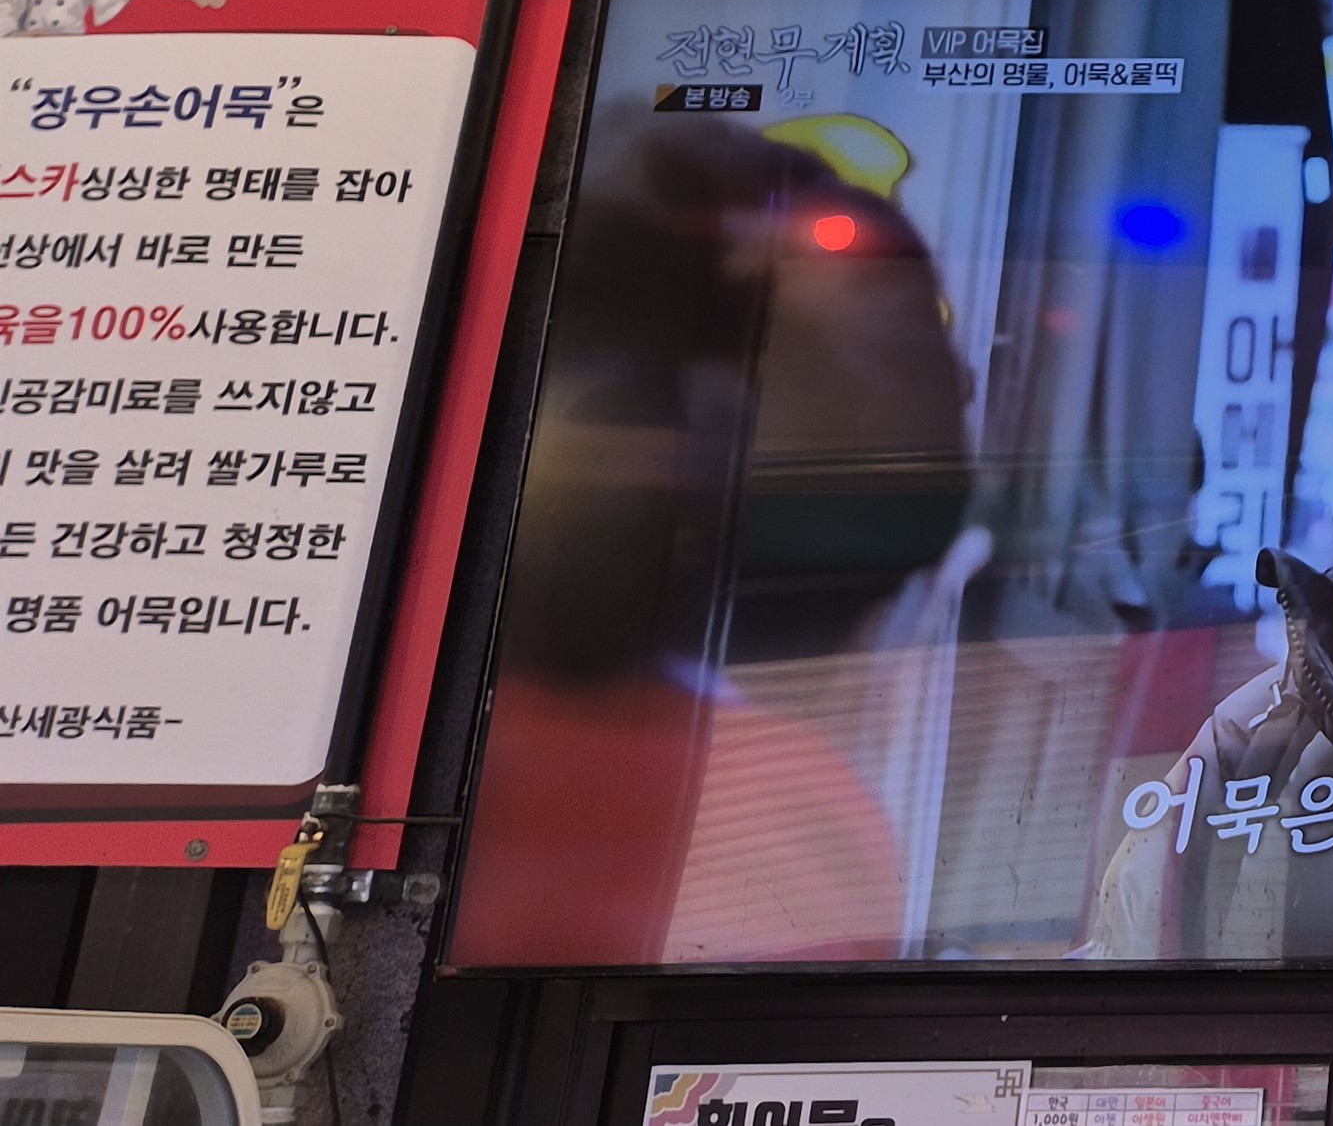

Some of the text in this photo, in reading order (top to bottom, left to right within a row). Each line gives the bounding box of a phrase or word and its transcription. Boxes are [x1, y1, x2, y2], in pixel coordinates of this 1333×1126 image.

[928, 29, 1044, 55] VIP 어묵집
[922, 61, 1178, 90] 부산의 명물, 어묵&물떡
[205, 166, 320, 202] 명태를
[335, 168, 413, 203] 잡아
[136, 233, 211, 268] 바로
[226, 234, 303, 268] 만든
[213, 378, 377, 416] 쓰지않고
[25, 449, 100, 486] 맛을
[114, 449, 192, 487] 살려
[207, 449, 367, 488] 쌀가루로
[50, 521, 207, 560] 건강하고
[222, 522, 345, 561] 청정한
[6, 594, 312, 636] 명품 어묵입니다.
